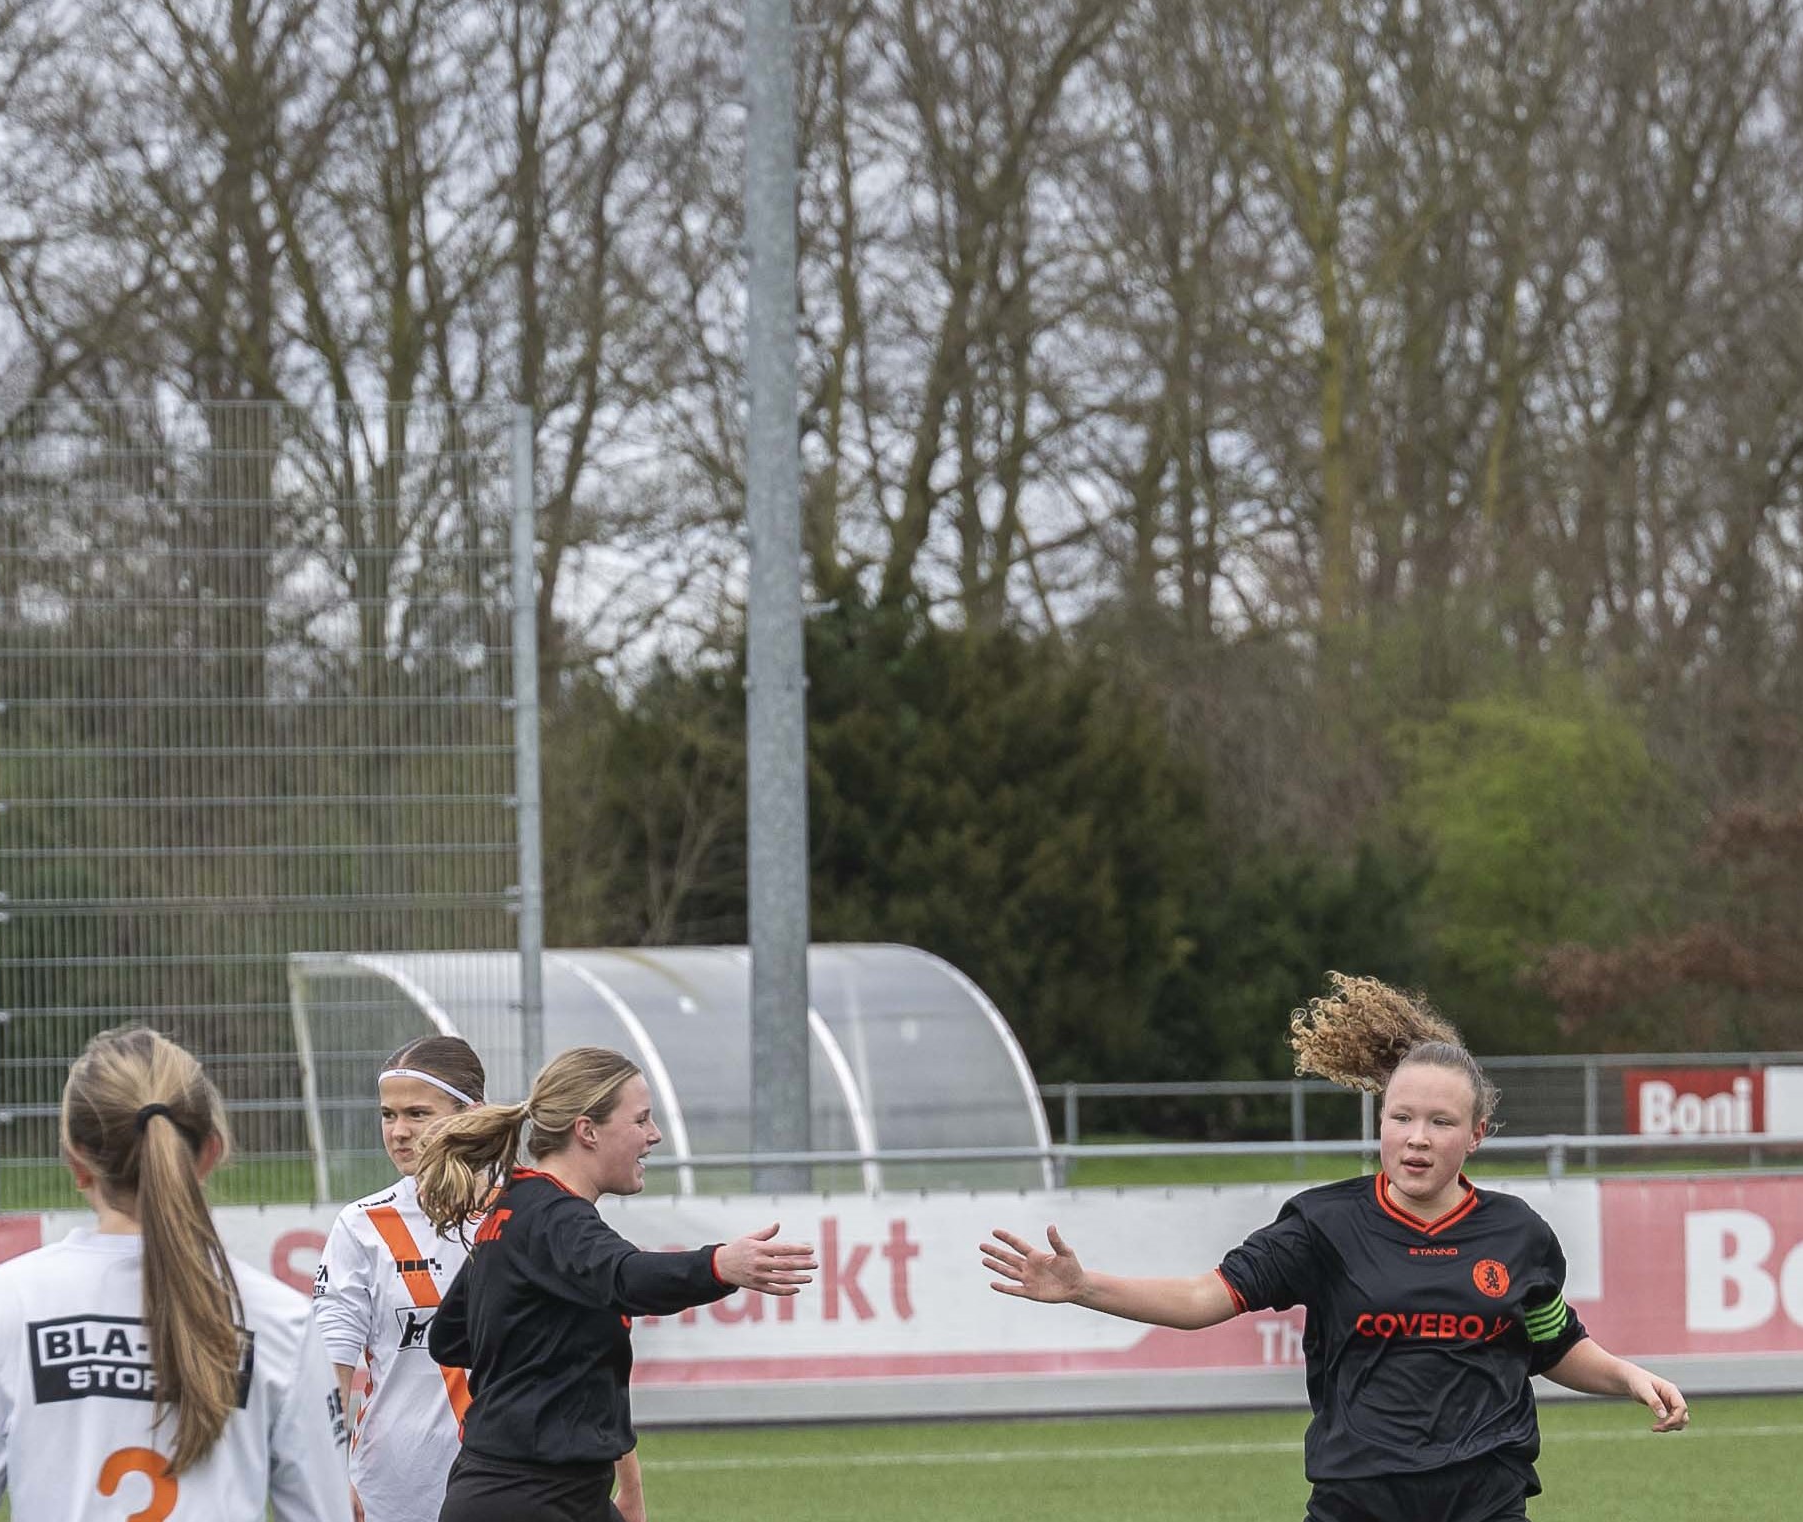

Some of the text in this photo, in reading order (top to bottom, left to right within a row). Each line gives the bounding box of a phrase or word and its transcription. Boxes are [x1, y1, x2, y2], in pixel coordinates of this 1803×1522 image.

[1639, 1076, 1753, 1134] Boni
[1408, 1247, 1459, 1256] STANNO
[1356, 1312, 1485, 1340] COVEBO
